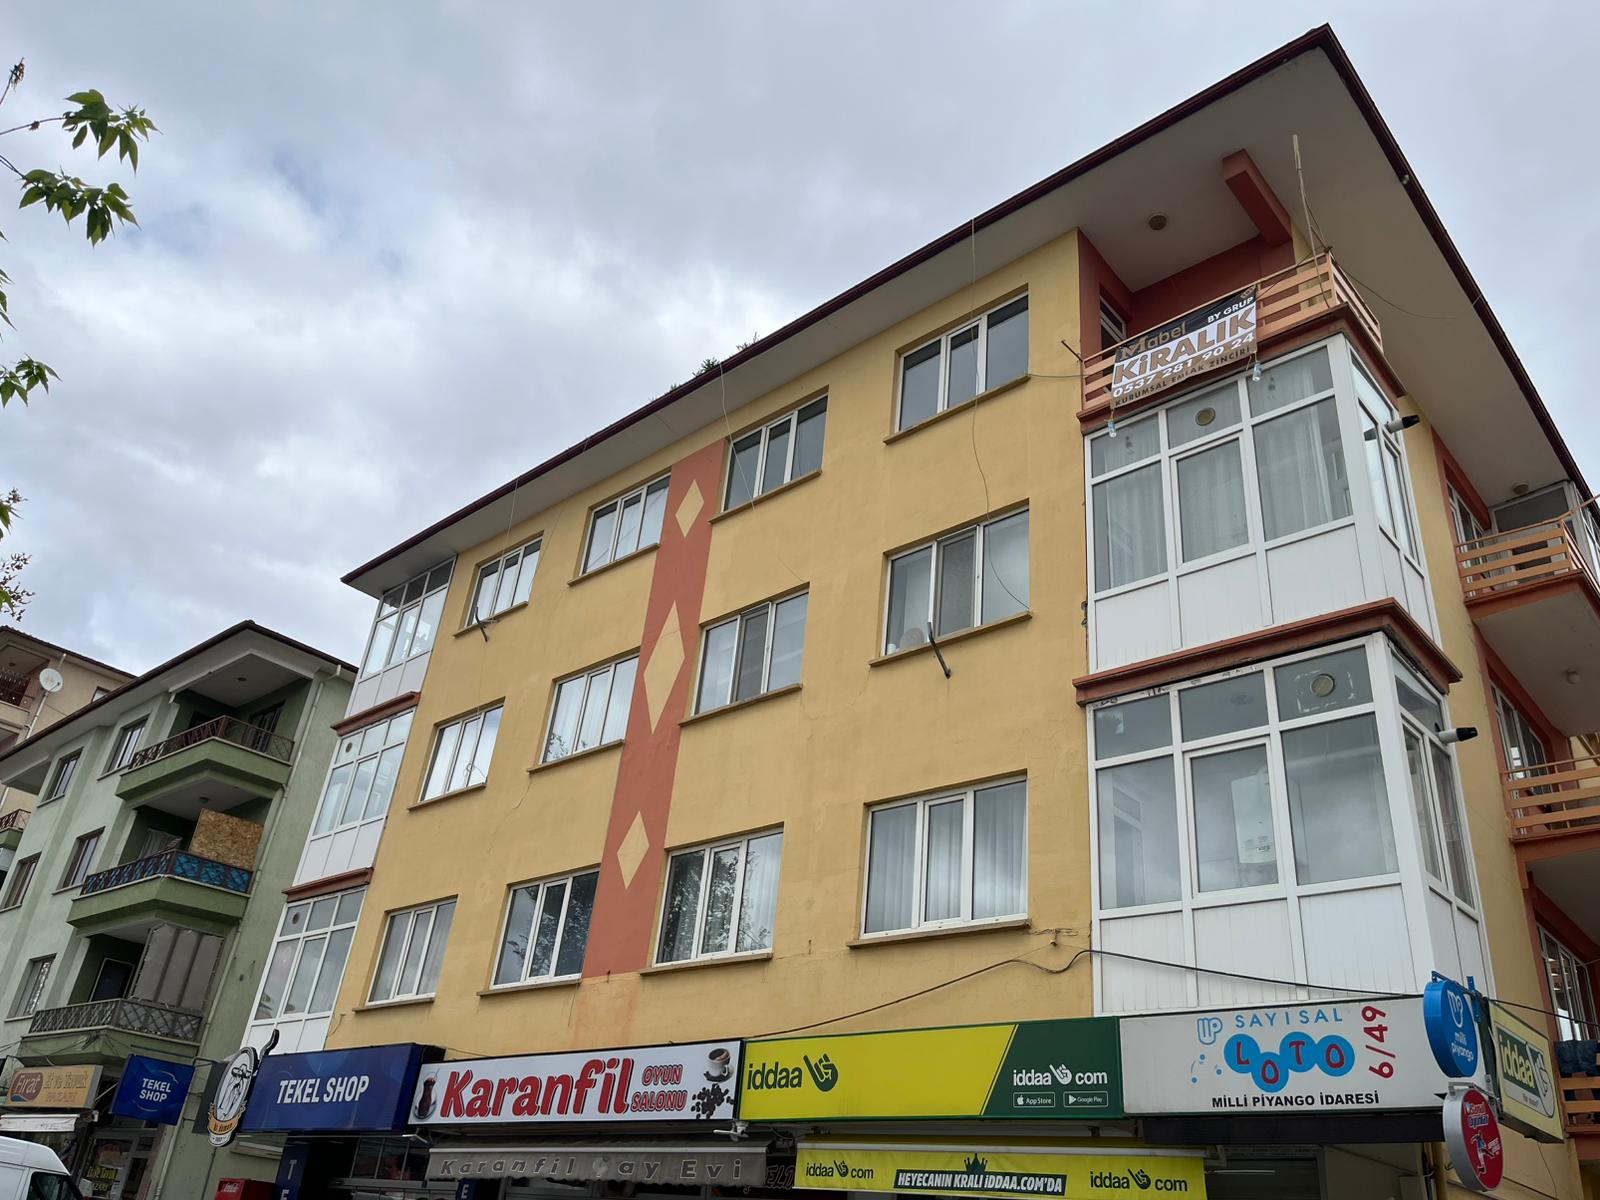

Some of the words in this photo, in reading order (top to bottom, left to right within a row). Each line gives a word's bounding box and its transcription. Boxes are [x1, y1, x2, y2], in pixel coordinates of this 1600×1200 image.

[1207, 311, 1222, 324] BY
[1223, 296, 1254, 316] GRUP
[1120, 320, 1187, 360] Mabel
[1113, 373, 1156, 398] 0537
[1162, 358, 1194, 378] 281
[1202, 346, 1225, 361] 90
[1231, 332, 1255, 350] 24
[1116, 380, 1168, 407] KURUMSAL
[1171, 364, 1206, 384] EMLAK
[1235, 1007, 1343, 1029] SAYISAL
[1361, 1005, 1396, 1079] 6/49
[1236, 1040, 1345, 1085] LOTO
[1499, 1033, 1536, 1089] iddaa
[142, 1078, 172, 1093] TEKEL
[641, 1064, 684, 1086] OYUN
[747, 1061, 803, 1090] iddaa
[1013, 1068, 1052, 1086] iddaa
[1075, 1072, 1108, 1085] com
[139, 1089, 168, 1103] SHOP
[277, 1078, 321, 1104] TEKEL
[323, 1075, 370, 1103] SHOP
[440, 1057, 634, 1118] Karanfil
[1212, 1094, 1248, 1108] MİLLİ
[1252, 1092, 1315, 1108] PİYANGO
[1320, 1089, 1380, 1106] İDARESİ
[630, 1089, 688, 1113] SALONU
[1026, 1097, 1038, 1105] App
[1038, 1096, 1052, 1105] Store
[1077, 1096, 1093, 1104] Google
[1093, 1096, 1103, 1104] Play
[440, 1156, 576, 1176] Karanfil
[680, 1159, 742, 1180] Evi
[805, 1162, 834, 1177] iddaa
[850, 1167, 874, 1179] com
[898, 1172, 951, 1188] HEYECANIN
[954, 1174, 983, 1189] KRALI
[1090, 1171, 1130, 1189] iddaa
[1154, 1176, 1188, 1192] com
